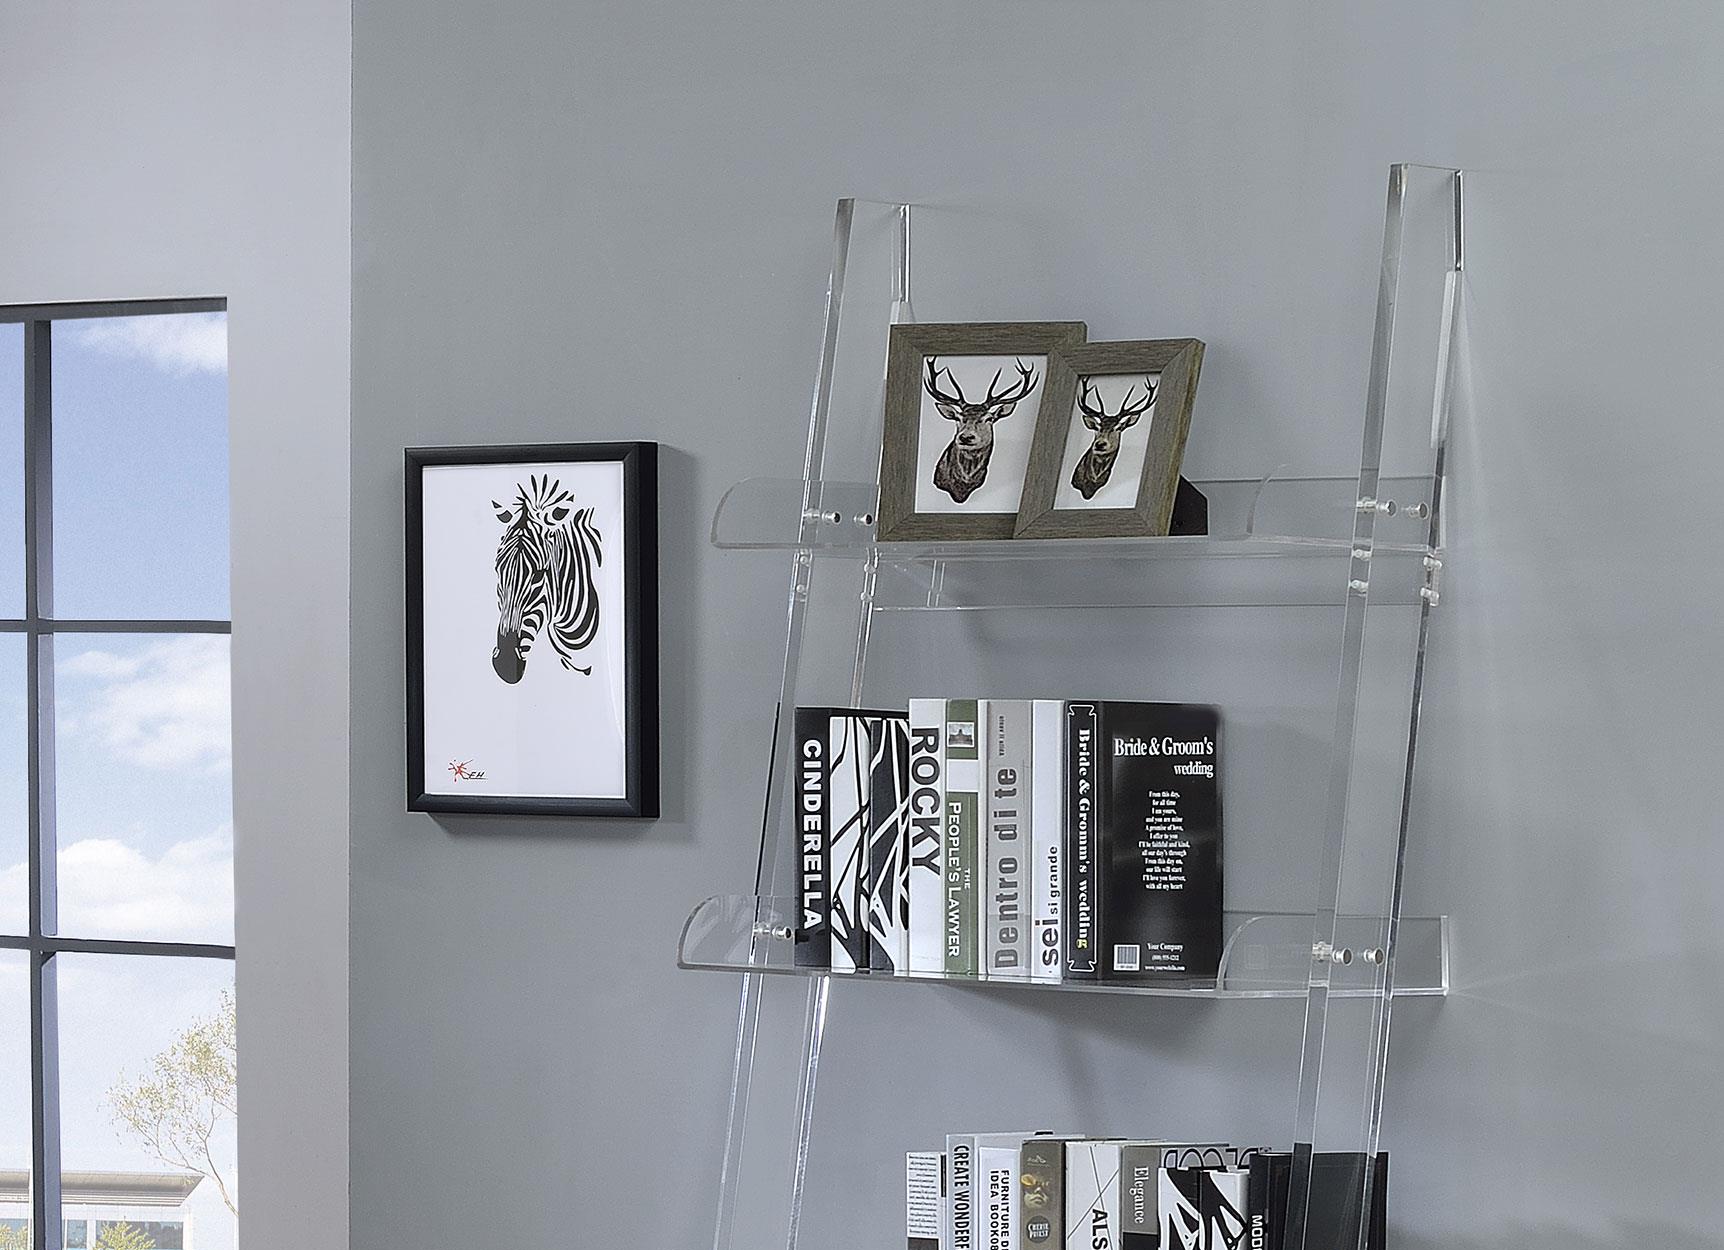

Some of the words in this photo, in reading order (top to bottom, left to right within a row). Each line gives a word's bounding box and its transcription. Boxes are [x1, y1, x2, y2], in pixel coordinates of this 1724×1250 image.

[1079, 728, 1091, 777] Bride
[1114, 737, 1147, 756] Bride
[1148, 737, 1160, 756] &
[1161, 736, 1214, 756] Groom's
[1173, 760, 1214, 779] wedding
[911, 727, 941, 876] ROCKY
[994, 768, 1017, 798] te
[1079, 779, 1091, 795] &
[803, 739, 822, 929] CINDERELLA
[993, 810, 1017, 841] di
[1048, 846, 1061, 898] grande
[948, 886, 960, 957] LAWYER
[994, 857, 1018, 968] Dentro
[1048, 901, 1058, 914] si
[1076, 879, 1091, 950] wedding
[1035, 919, 1058, 966] sei
[953, 1145, 970, 1187] CREATE
[990, 1170, 999, 1198] IDEA
[1000, 1169, 1010, 1238] FURNITURE
[1129, 1167, 1149, 1224] Elegance
